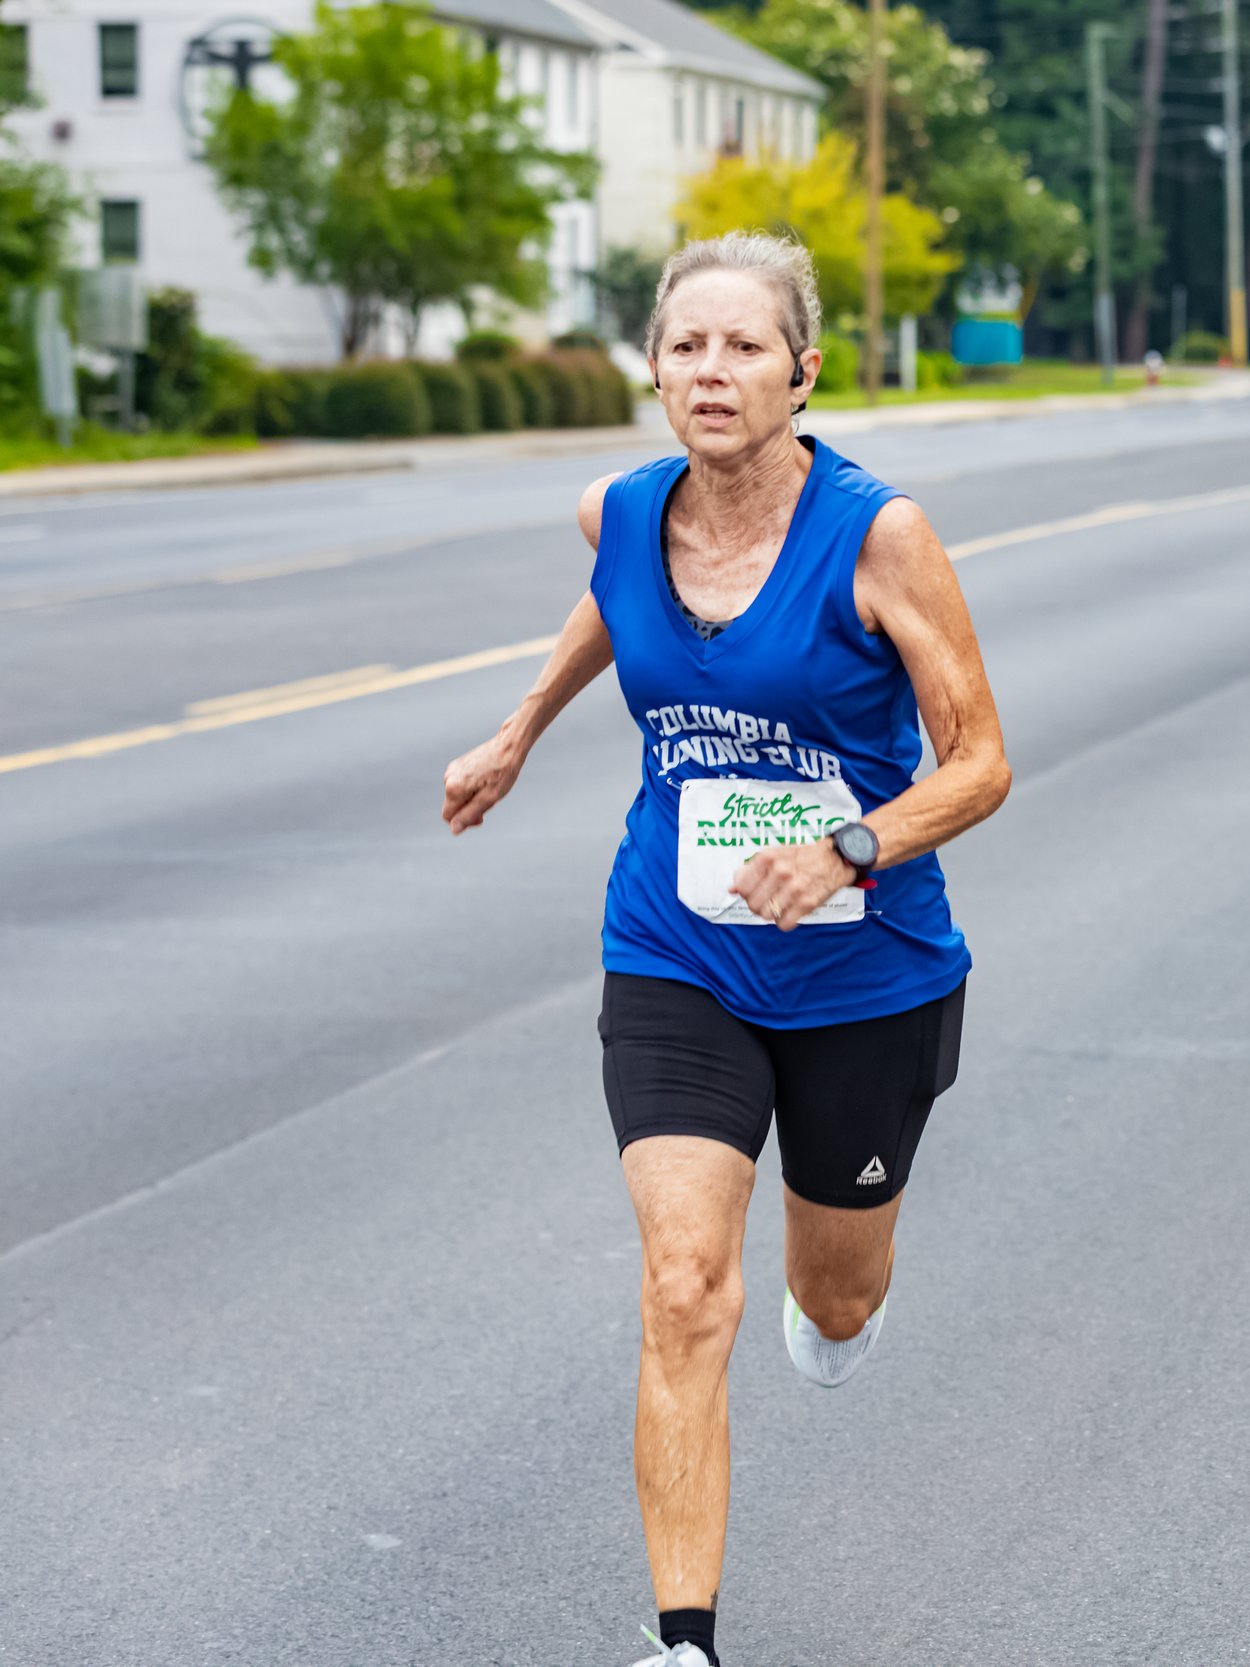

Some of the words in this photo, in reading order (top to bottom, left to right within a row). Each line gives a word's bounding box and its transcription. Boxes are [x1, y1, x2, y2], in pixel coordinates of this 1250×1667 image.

[646, 704, 792, 744] COLUMBIA
[652, 735, 760, 776] UNING
[760, 744, 842, 780] CLUB
[723, 793, 821, 827] Strictly
[856, 1174, 887, 1185] Reebok
